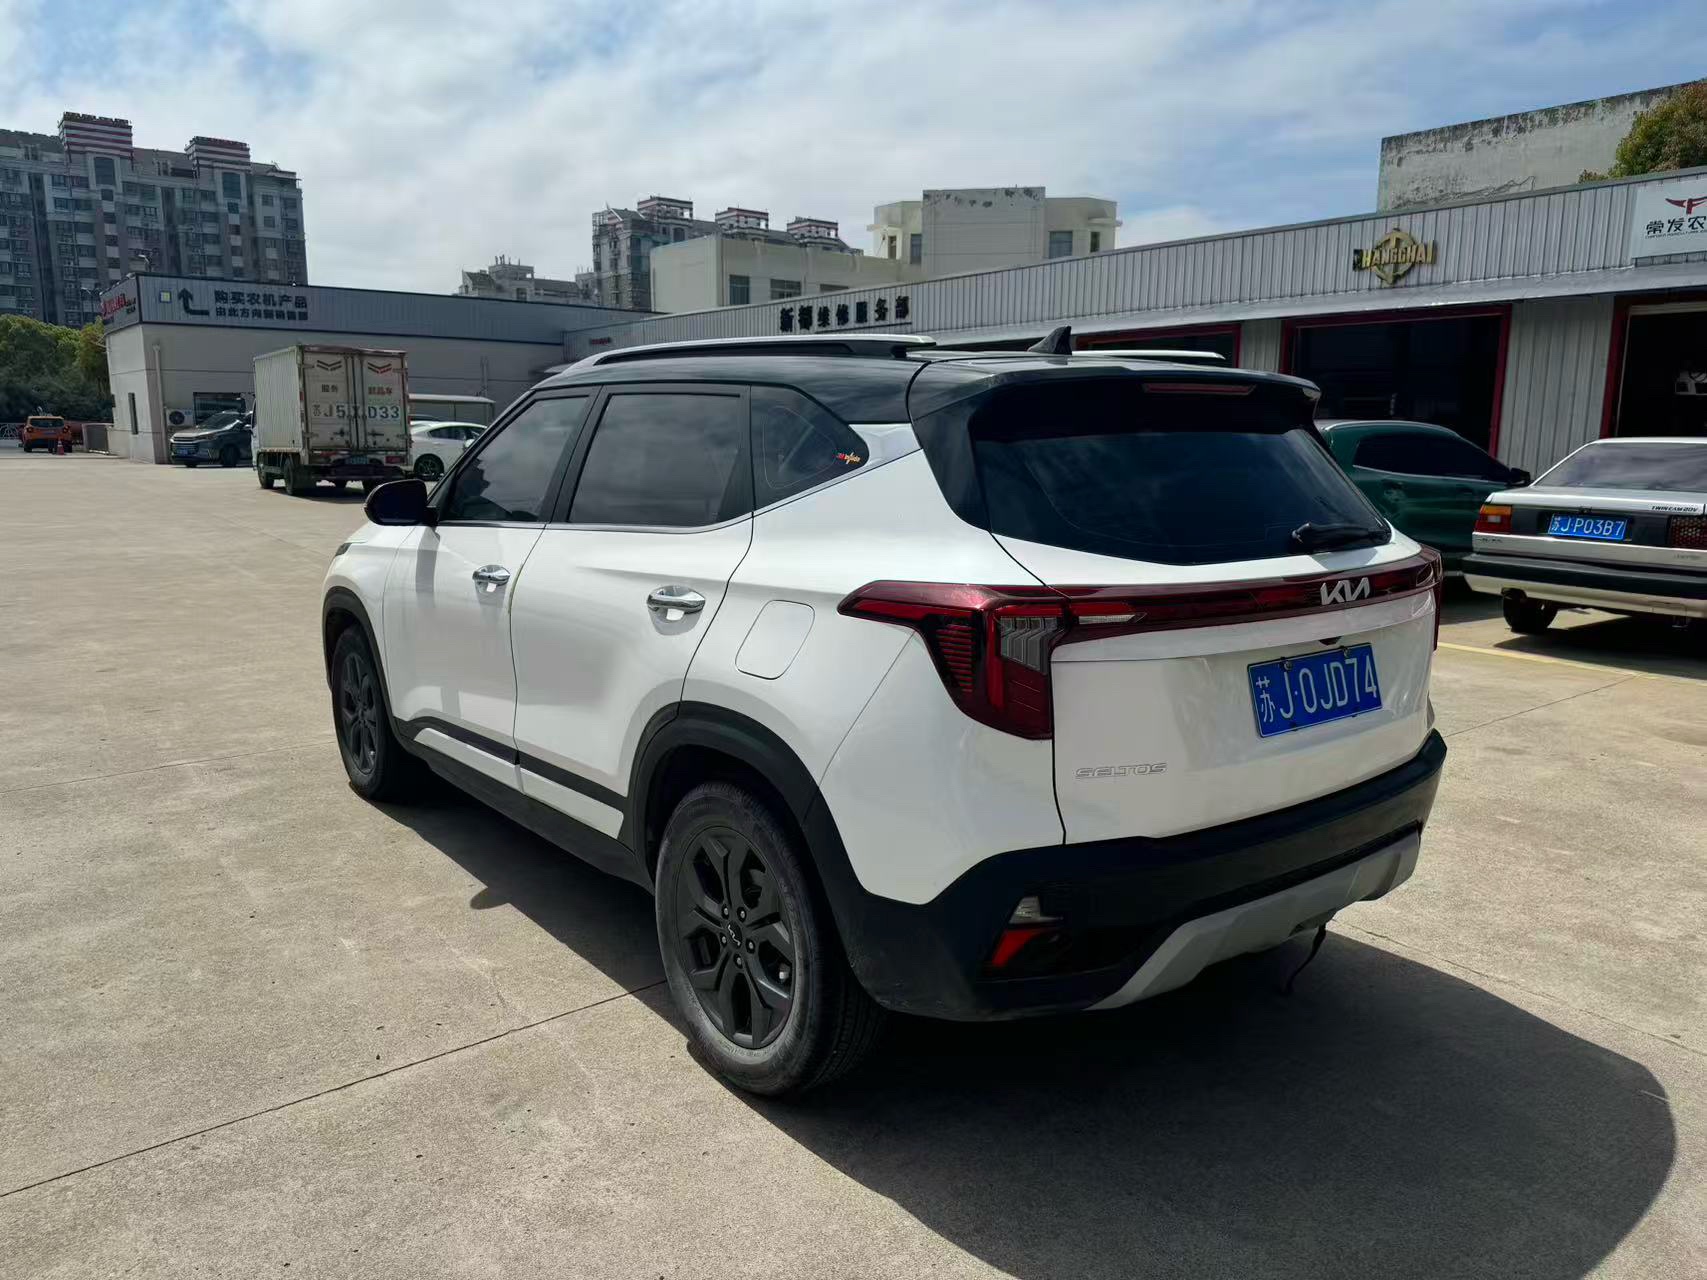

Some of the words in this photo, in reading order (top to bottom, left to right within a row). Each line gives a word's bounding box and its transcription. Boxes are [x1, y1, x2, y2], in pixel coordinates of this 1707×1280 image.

[1646, 216, 1707, 235] 常发农
[214, 290, 307, 309] 购买农机产品
[1320, 577, 1371, 605] KIA
[1075, 763, 1167, 779] SELTOS
